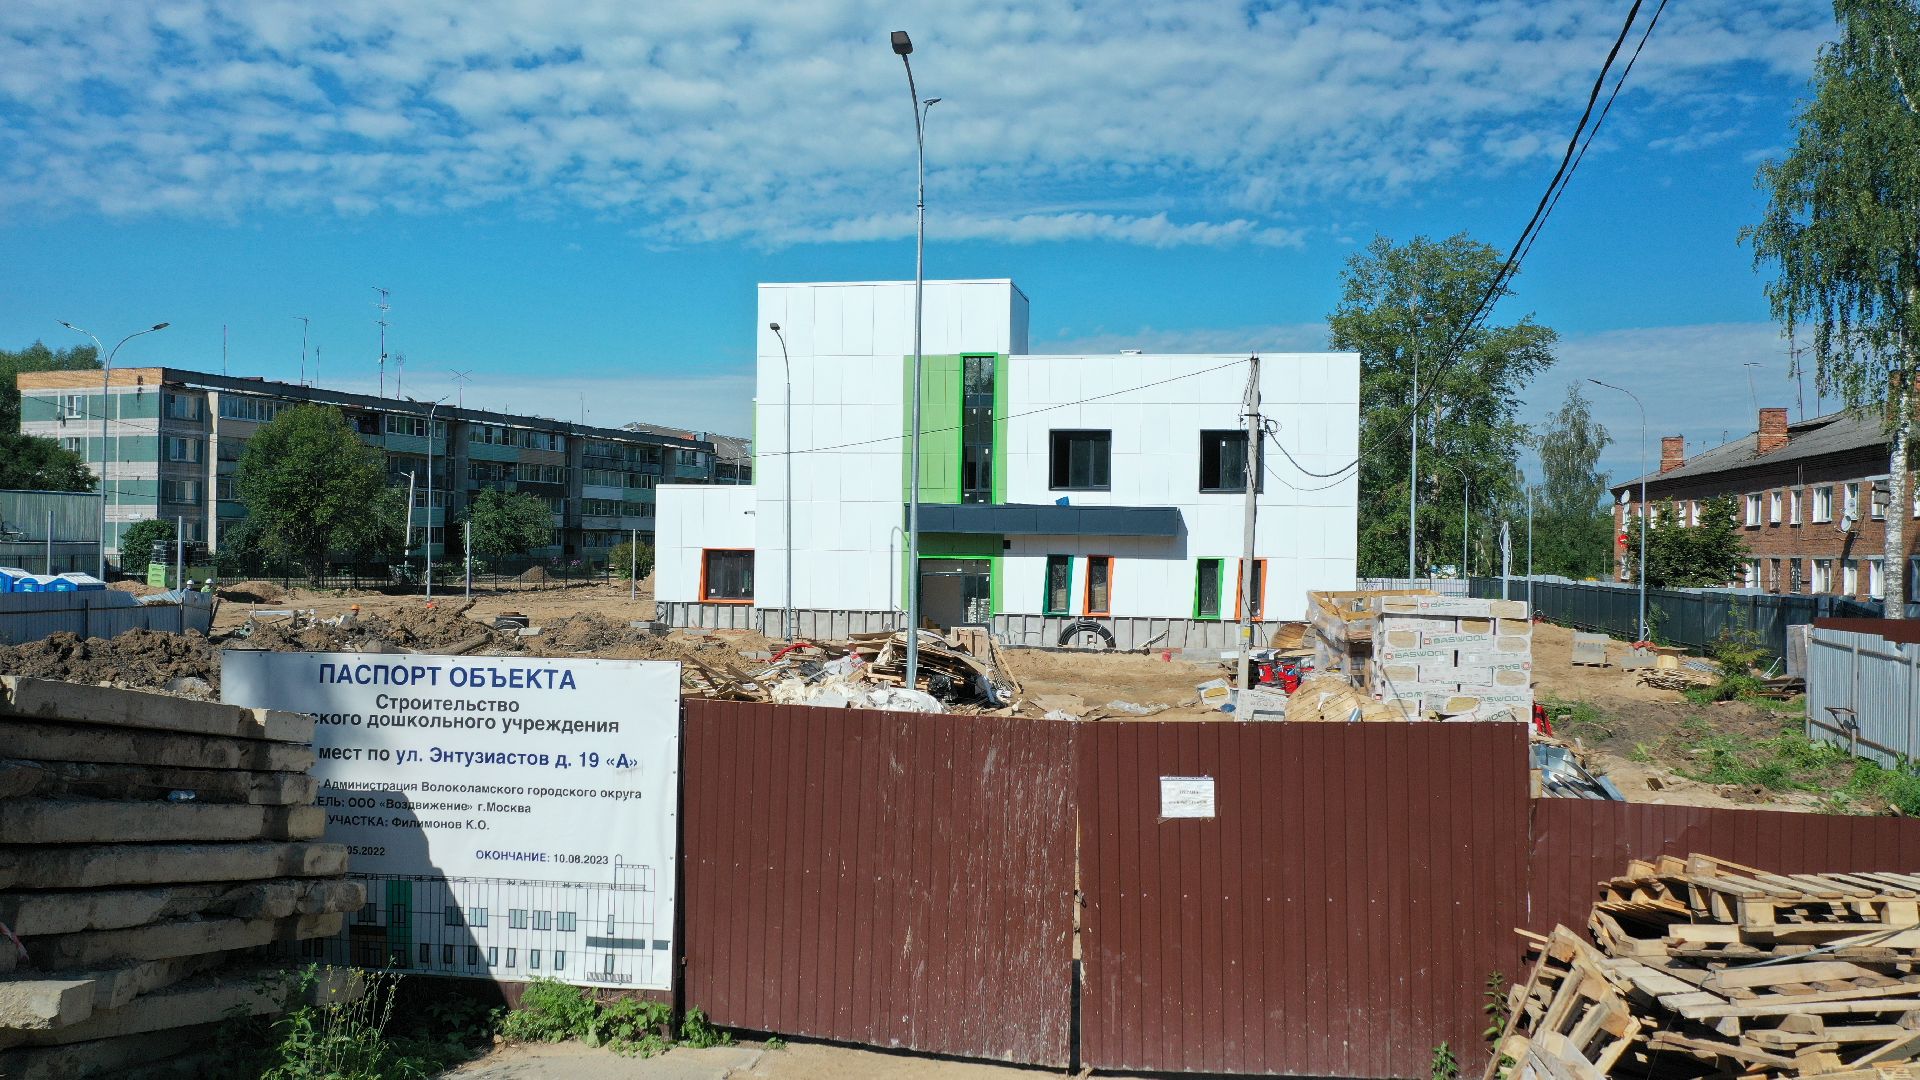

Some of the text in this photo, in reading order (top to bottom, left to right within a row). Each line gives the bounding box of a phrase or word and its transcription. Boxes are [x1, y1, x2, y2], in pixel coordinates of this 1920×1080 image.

[1433, 634, 1487, 645] BASWOOL
[1394, 650, 1448, 659] BASWOOL
[319, 663, 577, 690] ПАСПОРТ ОБЪЕКТА
[375, 693, 520, 713] Строительство
[308, 712, 620, 735] ского дошкольного учреждения
[318, 747, 638, 769] мест по ул. Энтузиастов д. 19 «А»
[323, 779, 418, 792] Администрация
[421, 781, 524, 795] Волоколамского
[527, 787, 597, 798] городского
[600, 789, 642, 801] округа
[312, 795, 346, 808] ЕЛЬ:
[348, 797, 376, 809] ООО
[478, 802, 531, 813] г.Москва
[328, 814, 490, 831] УЧАСТКА: Филимонов К.О.
[346, 845, 386, 856] 05.2022
[475, 850, 550, 863] ОКОНЧАНИЕ:
